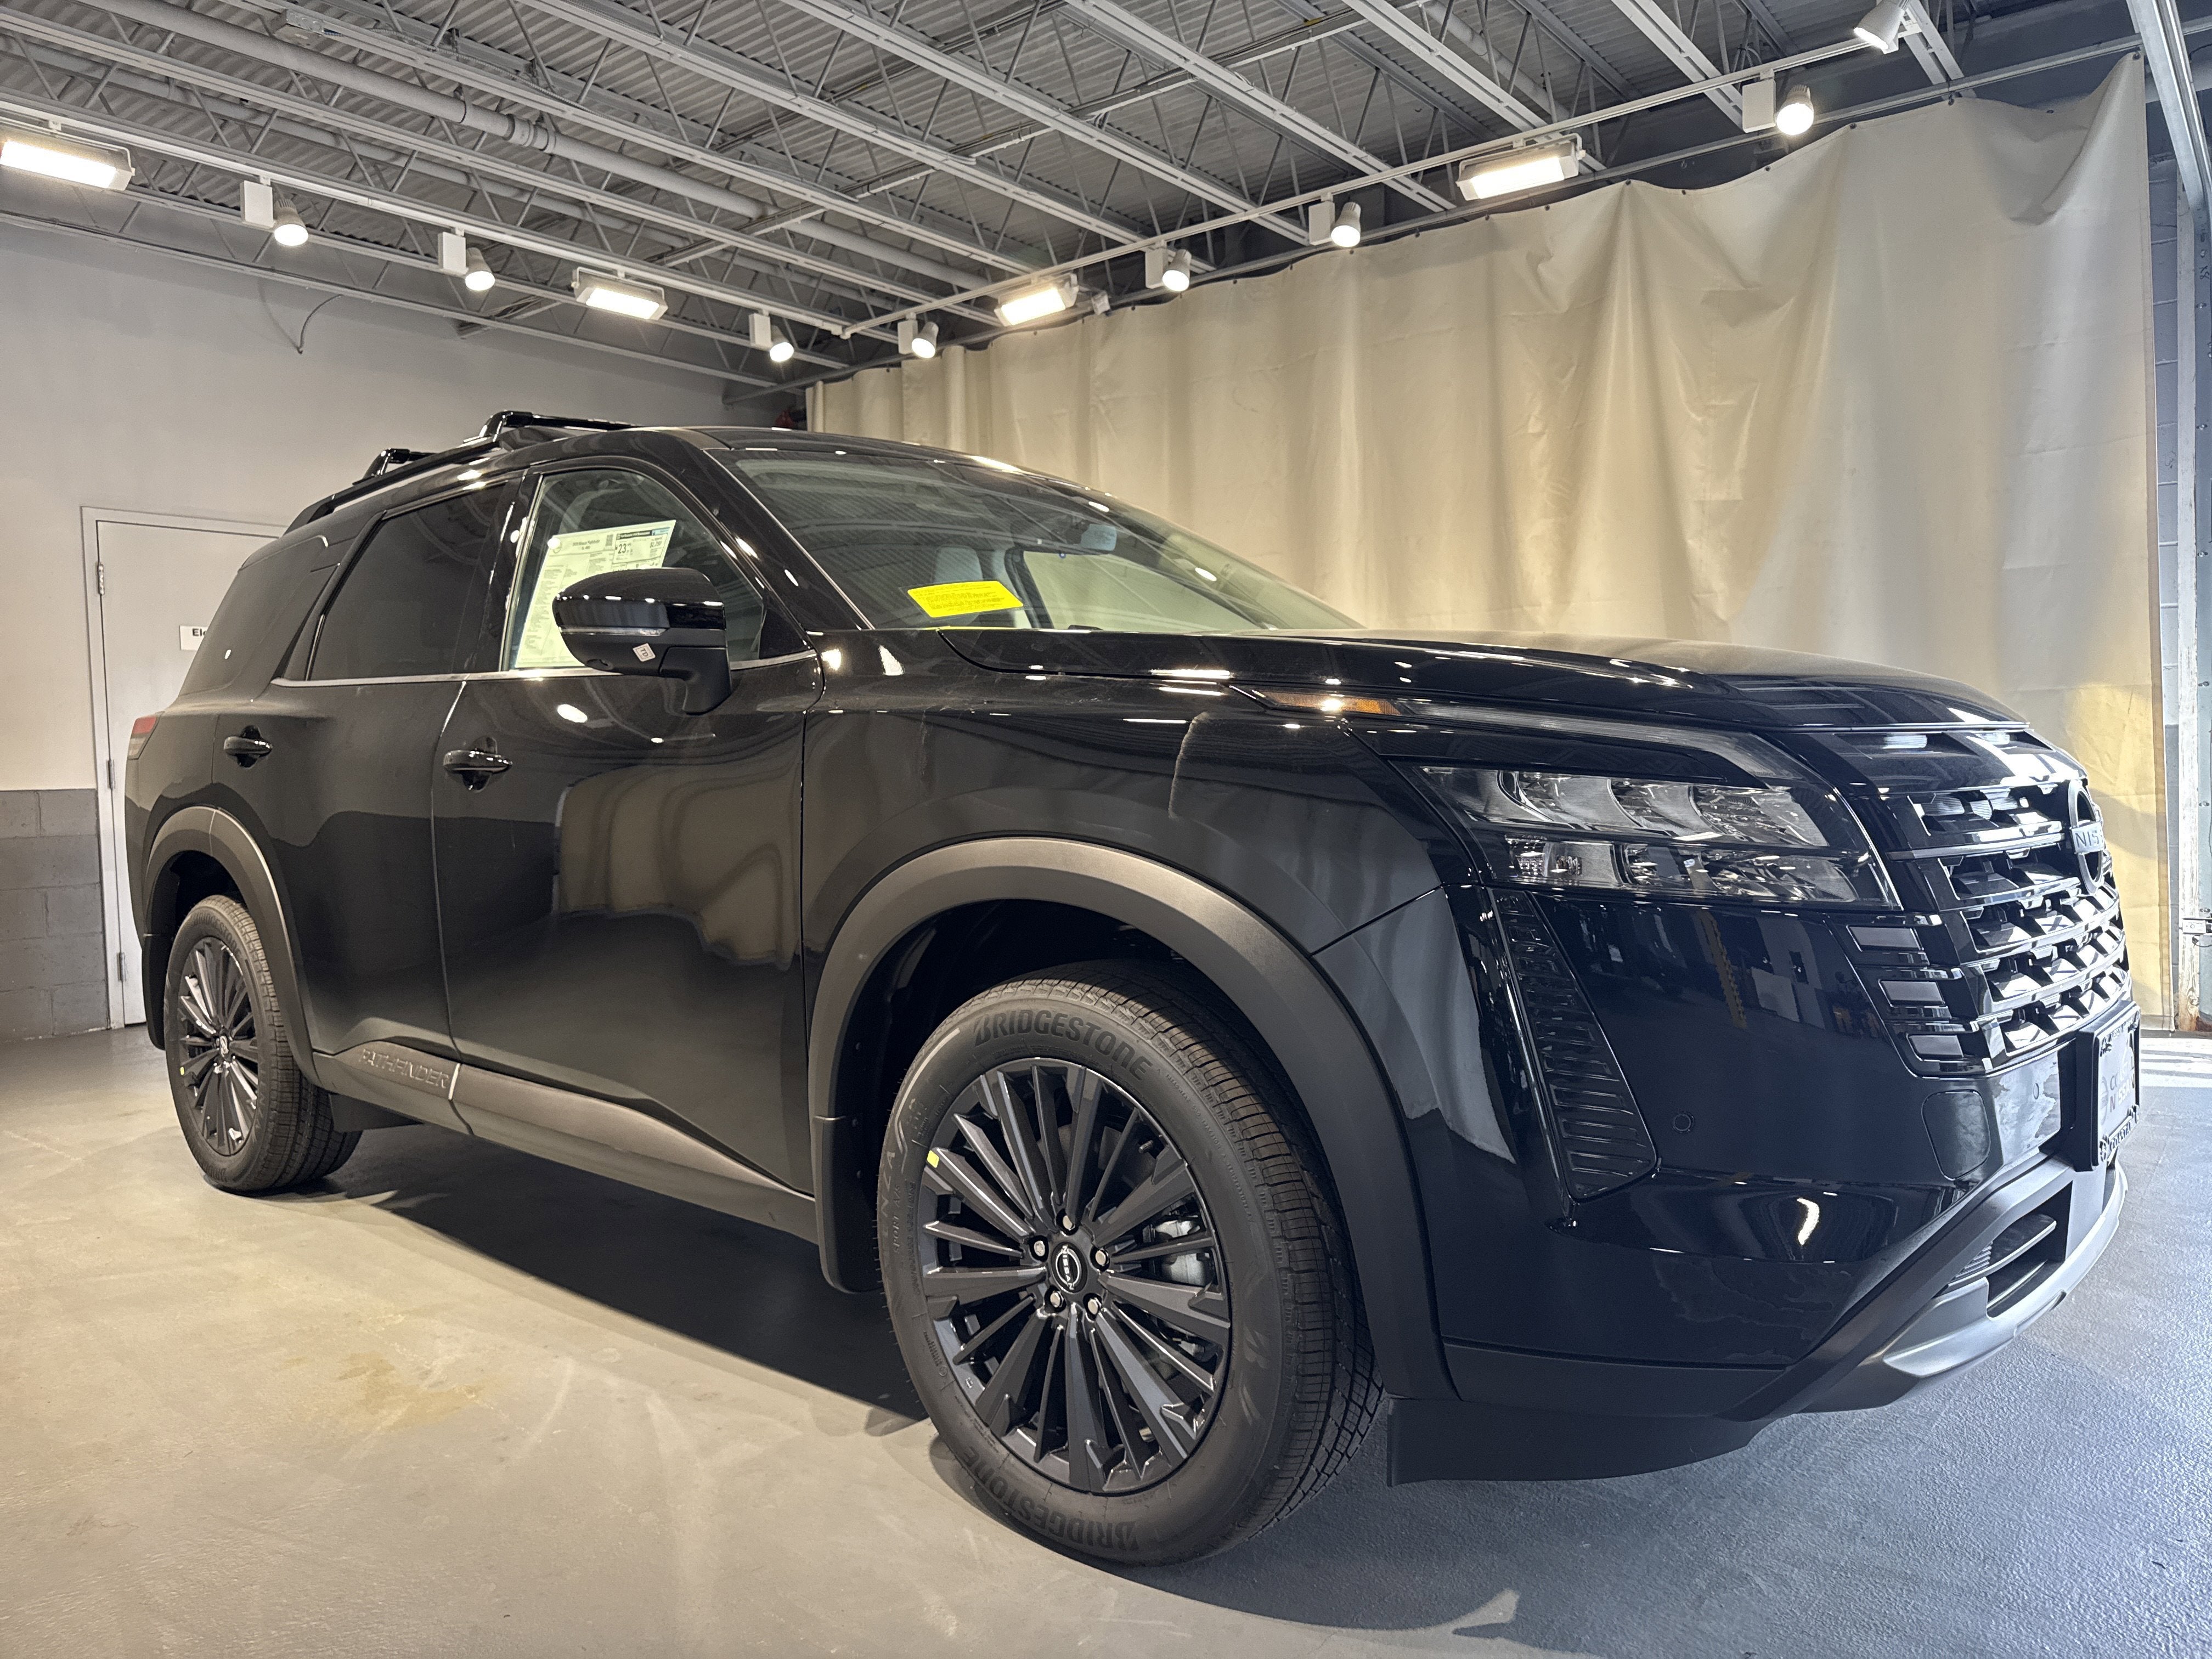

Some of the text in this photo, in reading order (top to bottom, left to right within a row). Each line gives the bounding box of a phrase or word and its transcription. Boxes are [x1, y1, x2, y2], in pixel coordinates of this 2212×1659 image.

[618, 543, 627, 554] 23
[974, 1009, 1153, 1081] BRIDGESTONE
[358, 1048, 450, 1089] PATHFINDER
[893, 1184, 901, 1207] A/S
[1062, 1244, 1074, 1290] NISSAN
[963, 1446, 1139, 1550] BRIDGESTONE
